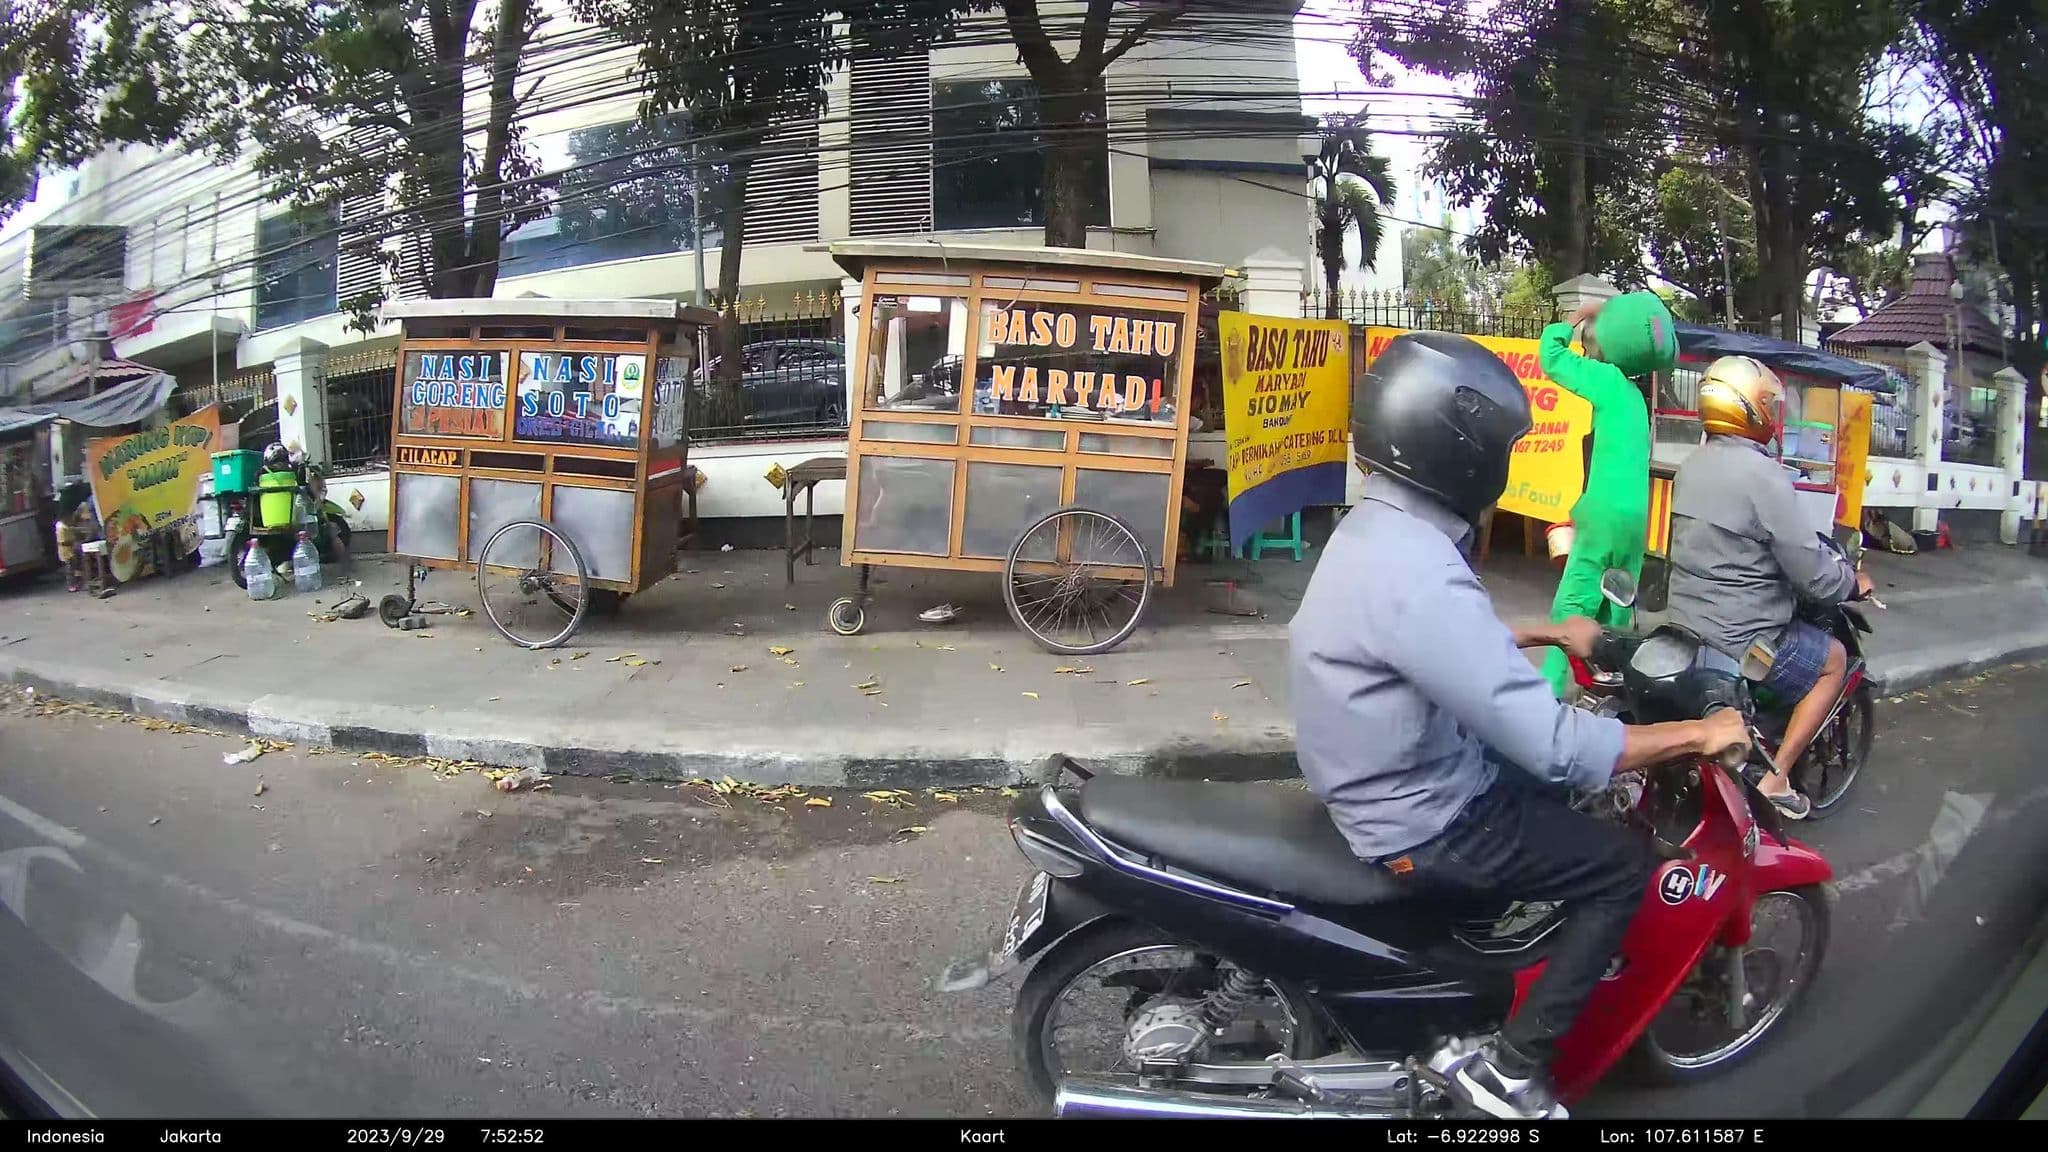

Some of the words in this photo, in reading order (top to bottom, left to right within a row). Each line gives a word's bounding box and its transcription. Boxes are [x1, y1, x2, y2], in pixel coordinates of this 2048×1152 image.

[987, 309, 1077, 348] BASO
[1090, 315, 1176, 357] TAHU
[1247, 325, 1288, 371] BASO
[1293, 329, 1330, 368] TAHU
[417, 355, 491, 381] NASI
[532, 355, 617, 384] NASI
[412, 380, 506, 409] GORENG
[990, 365, 1162, 413] MARYADI
[521, 390, 621, 419] SOTO
[1527, 421, 1569, 435] SANAN
[400, 448, 457, 466] CILACAP
[1534, 439, 1564, 453] 7249
